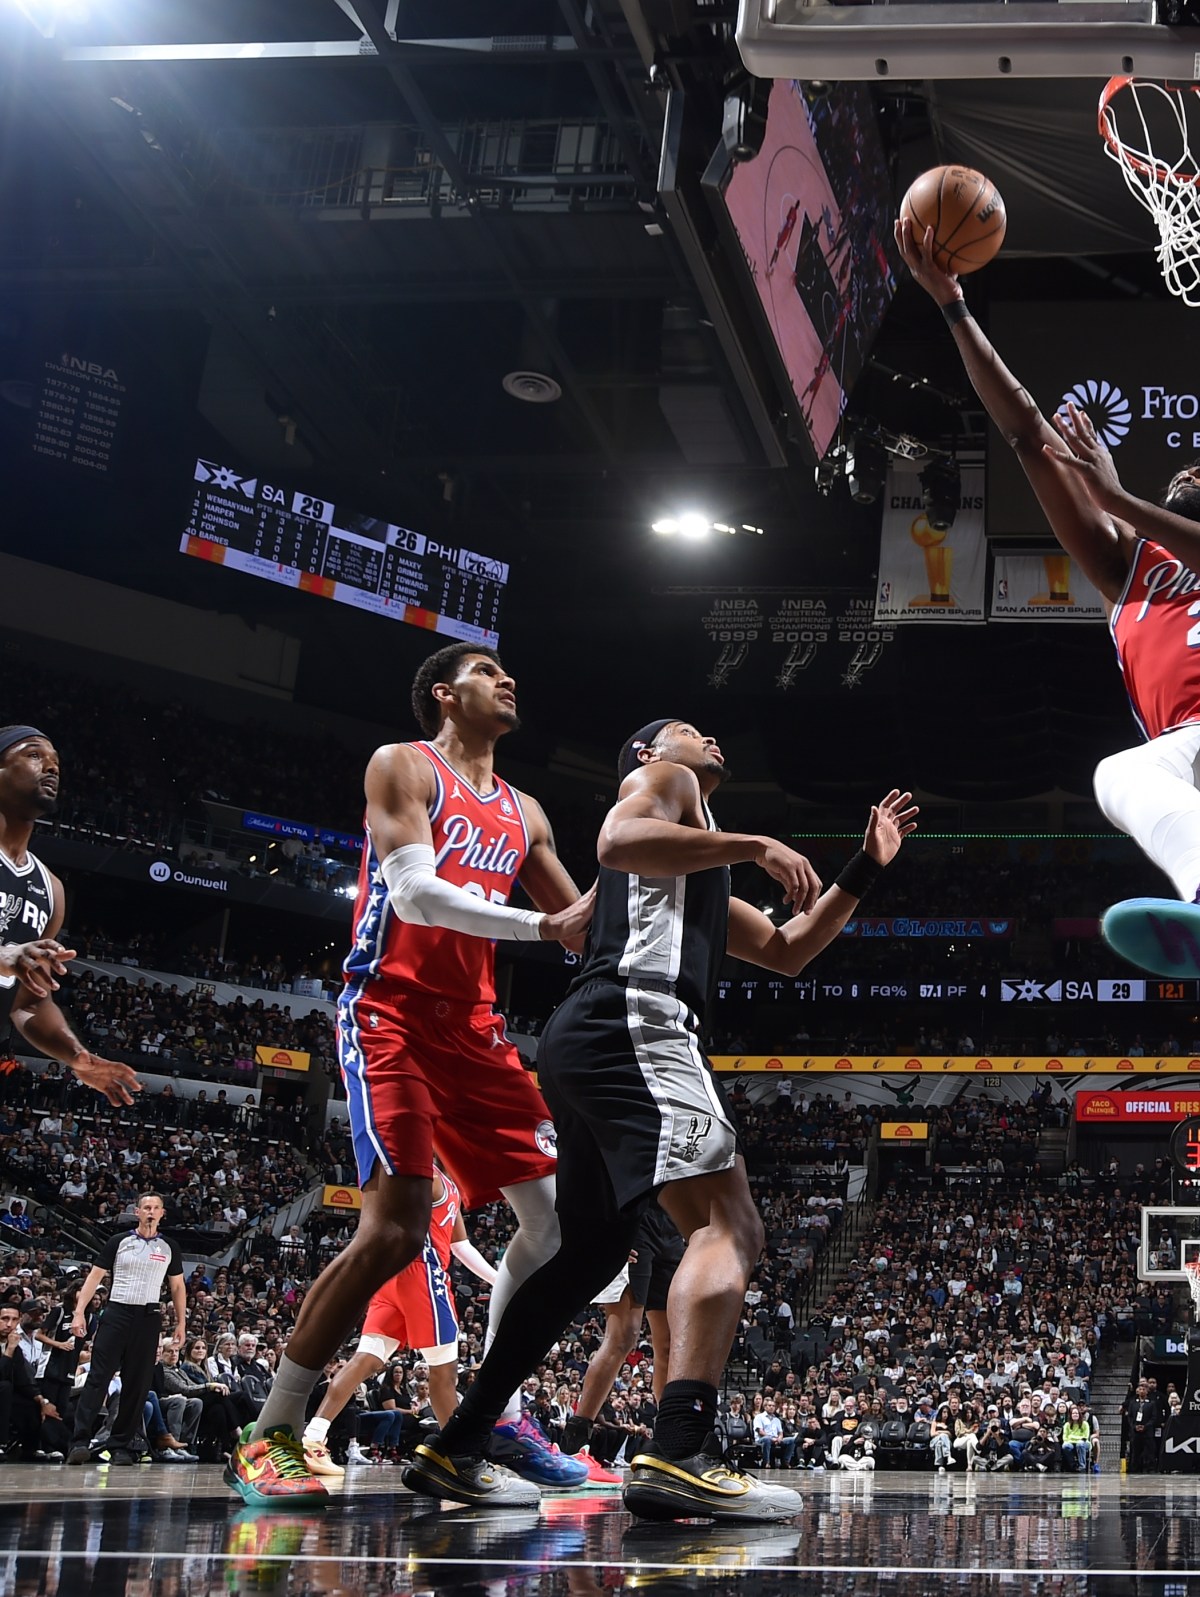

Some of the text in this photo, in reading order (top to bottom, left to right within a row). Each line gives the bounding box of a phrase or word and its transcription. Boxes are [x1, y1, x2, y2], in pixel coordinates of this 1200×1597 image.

[45, 361, 91, 381] DIVISION
[70, 356, 119, 382] NBA
[76, 434, 111, 448] 2001-02
[206, 493, 254, 515] WEMBANYAMA
[261, 484, 324, 520] SA 29
[890, 496, 984, 509] CHANS
[204, 502, 235, 518] HARPER
[201, 521, 216, 532] FOX
[202, 512, 240, 530] JOHNSON
[185, 527, 230, 546] 40 BARNES
[394, 529, 418, 551] 26
[426, 540, 458, 563] PHI
[398, 557, 422, 570] MAXEY
[397, 566, 424, 581] GRIMES
[395, 574, 430, 592] EDWARDS
[720, 600, 759, 610] NBA
[788, 600, 827, 610] NBA
[878, 608, 898, 616] SAN
[708, 630, 758, 642] 1999
[772, 631, 828, 642] 2003
[838, 631, 894, 642] 2005
[282, 825, 308, 838] ULTRA
[436, 814, 520, 876] Phila
[174, 871, 228, 891] Ownwell
[862, 918, 984, 936] LA GLORIA
[197, 982, 216, 994] 126
[822, 985, 987, 998] TO 6 FG% 57.1 PF 4
[1066, 982, 1093, 1000] SA
[1112, 983, 1131, 999] 29
[1158, 984, 1184, 998] 12.1
[985, 1078, 1000, 1086] 128
[1126, 1102, 1171, 1112] OFFICIAL
